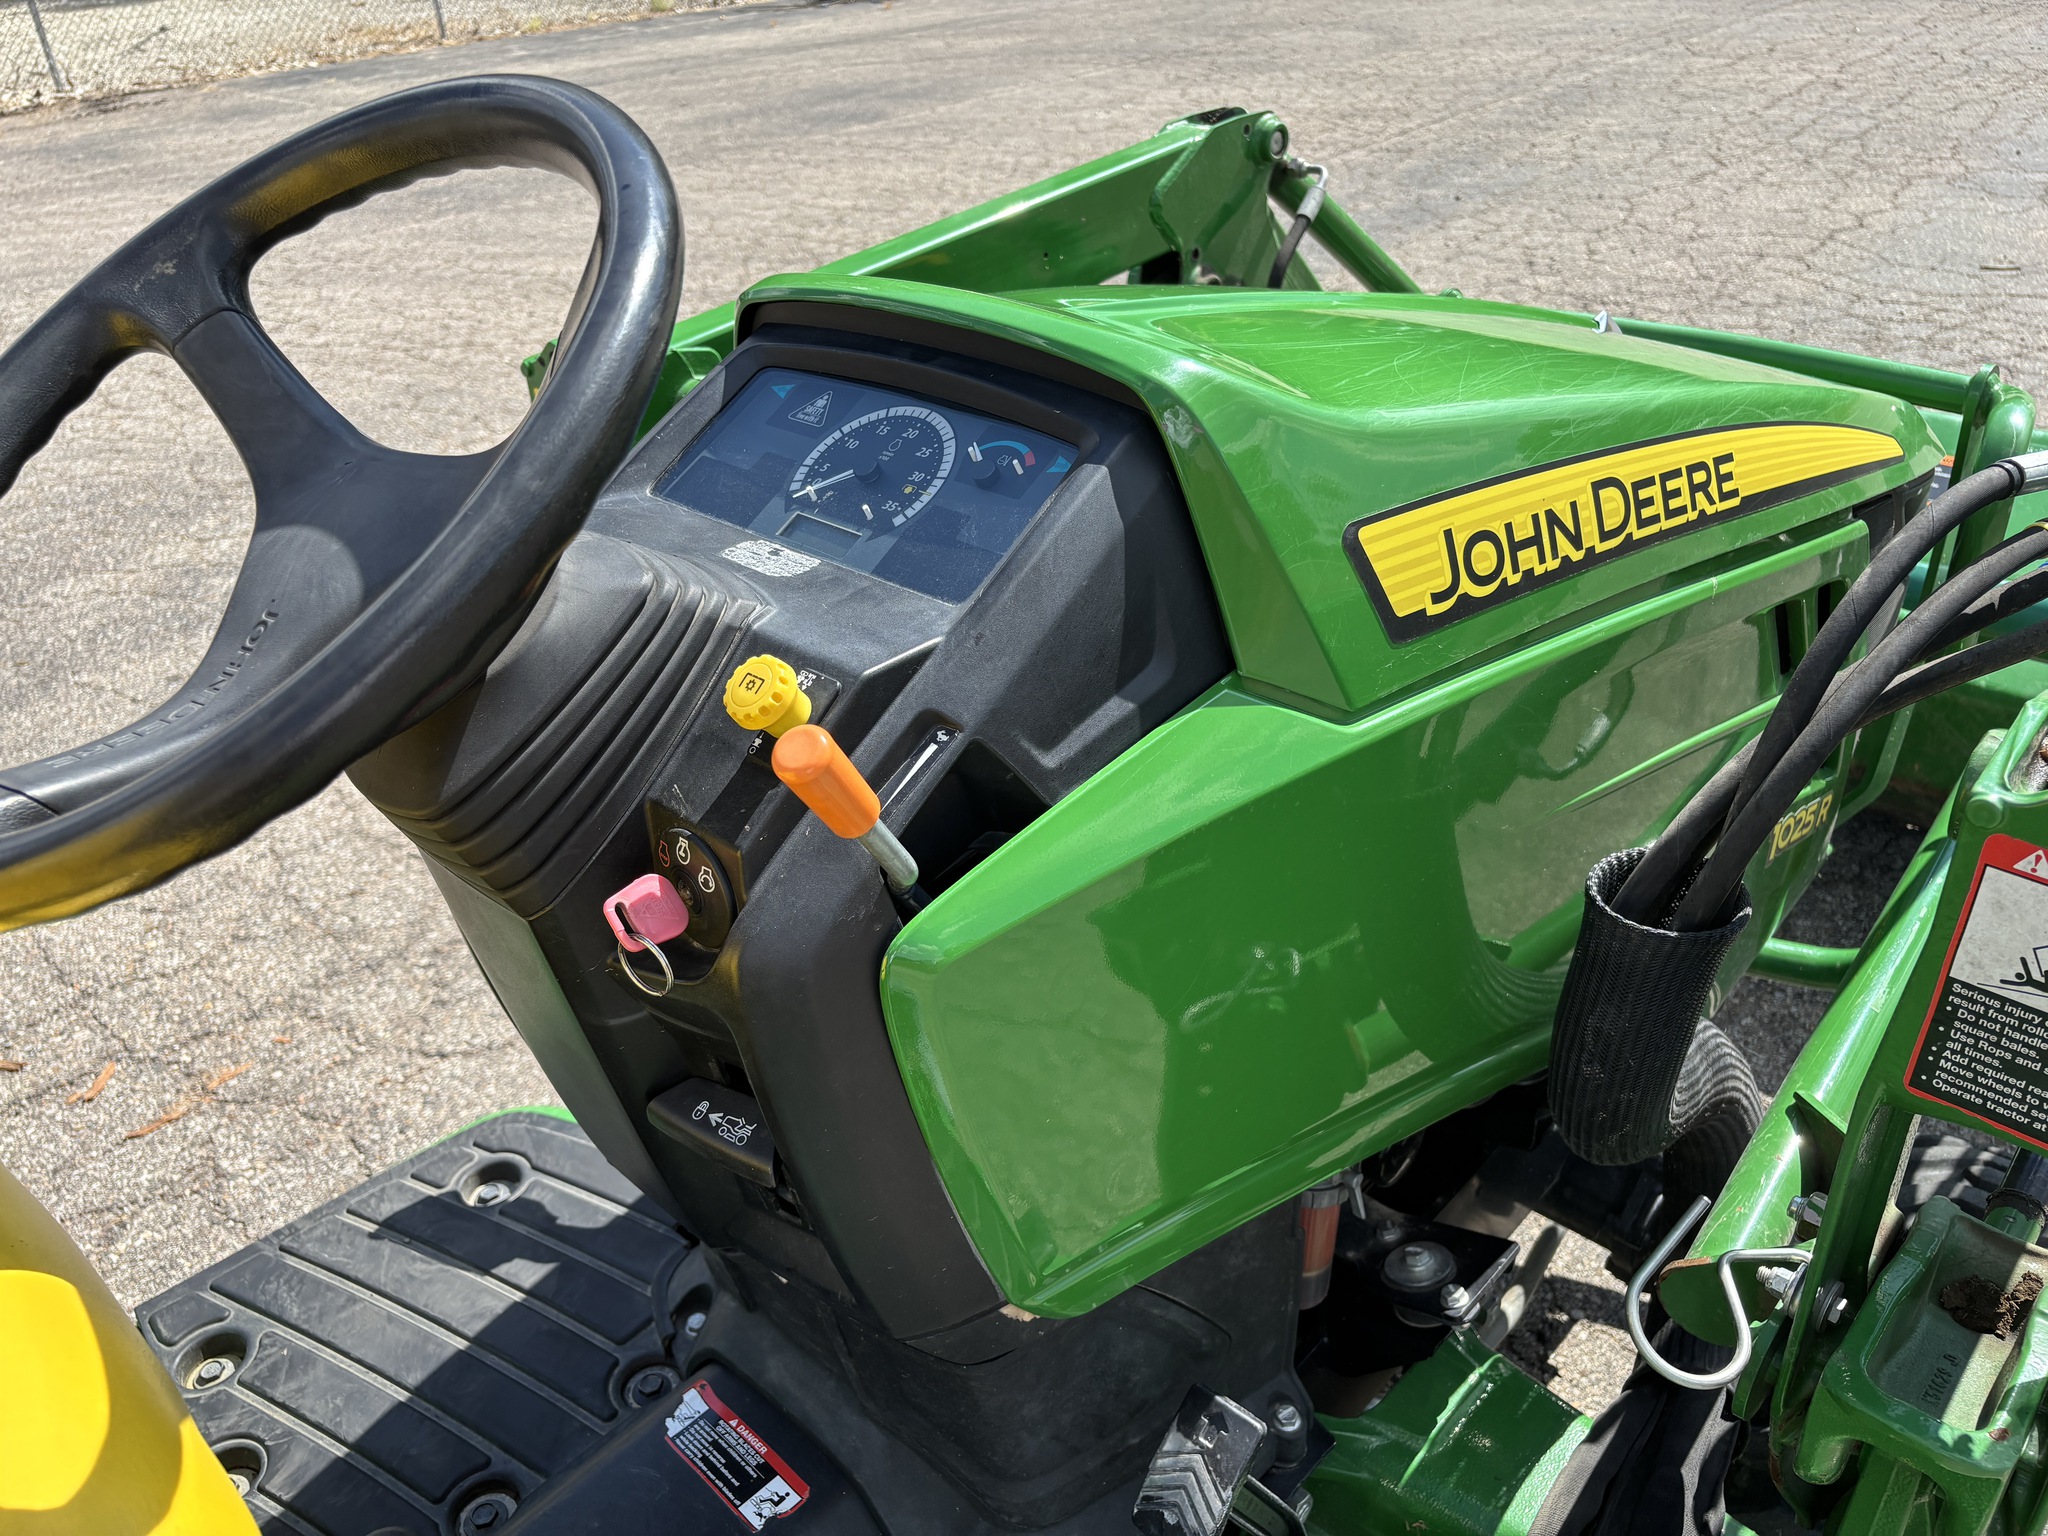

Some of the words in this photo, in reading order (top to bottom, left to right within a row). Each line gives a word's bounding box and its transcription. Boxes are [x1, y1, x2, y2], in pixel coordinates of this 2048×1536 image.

[846, 439, 860, 449] 10
[876, 425, 891, 435] 15
[902, 428, 919, 439] 20
[819, 463, 831, 472] 5
[915, 447, 932, 458] 25
[908, 471, 925, 482] 30
[881, 500, 899, 512] 35
[1431, 500, 1584, 604] JOHN
[1590, 452, 1740, 545] DEERE
[1948, 995, 1986, 1014] result
[1988, 1009, 2019, 1027] from
[1952, 983, 2001, 1008] Serious
[2004, 1003, 2043, 1024] injury
[1953, 1021, 1998, 1042] square
[2000, 1038, 2040, 1059] bales.
[1957, 1009, 1976, 1022] Do
[1978, 1019, 2001, 1032] not
[2004, 1026, 2048, 1050] handle
[1946, 1041, 1962, 1052] all
[1964, 1046, 2003, 1068] times.
[1950, 1029, 1975, 1045] Use
[1978, 1040, 2012, 1060] Rops
[2015, 1056, 2042, 1071] and
[1939, 1059, 1974, 1079] Move
[1977, 1075, 2023, 1099] wheels
[2026, 1094, 2040, 1106] to
[1942, 1050, 1969, 1066] Add
[1971, 1061, 2026, 1088] required
[2028, 1085, 2048, 1098] rea
[1932, 1079, 1984, 1105] Operate
[1986, 1099, 2031, 1124] tractor
[2032, 1121, 2048, 1132] at
[1935, 1070, 2029, 1113] recommended
[716, 1426, 727, 1434] OFF
[724, 1434, 738, 1446] ARMS
[736, 1444, 747, 1455] AND
[744, 1453, 758, 1466] LEGS
[718, 1420, 740, 1440] ROTATING
[738, 1438, 757, 1456] BLADES
[754, 1454, 766, 1464] CUT
[726, 1447, 742, 1462] children
[737, 1425, 768, 1454] DANGER
[692, 1457, 708, 1471] children
